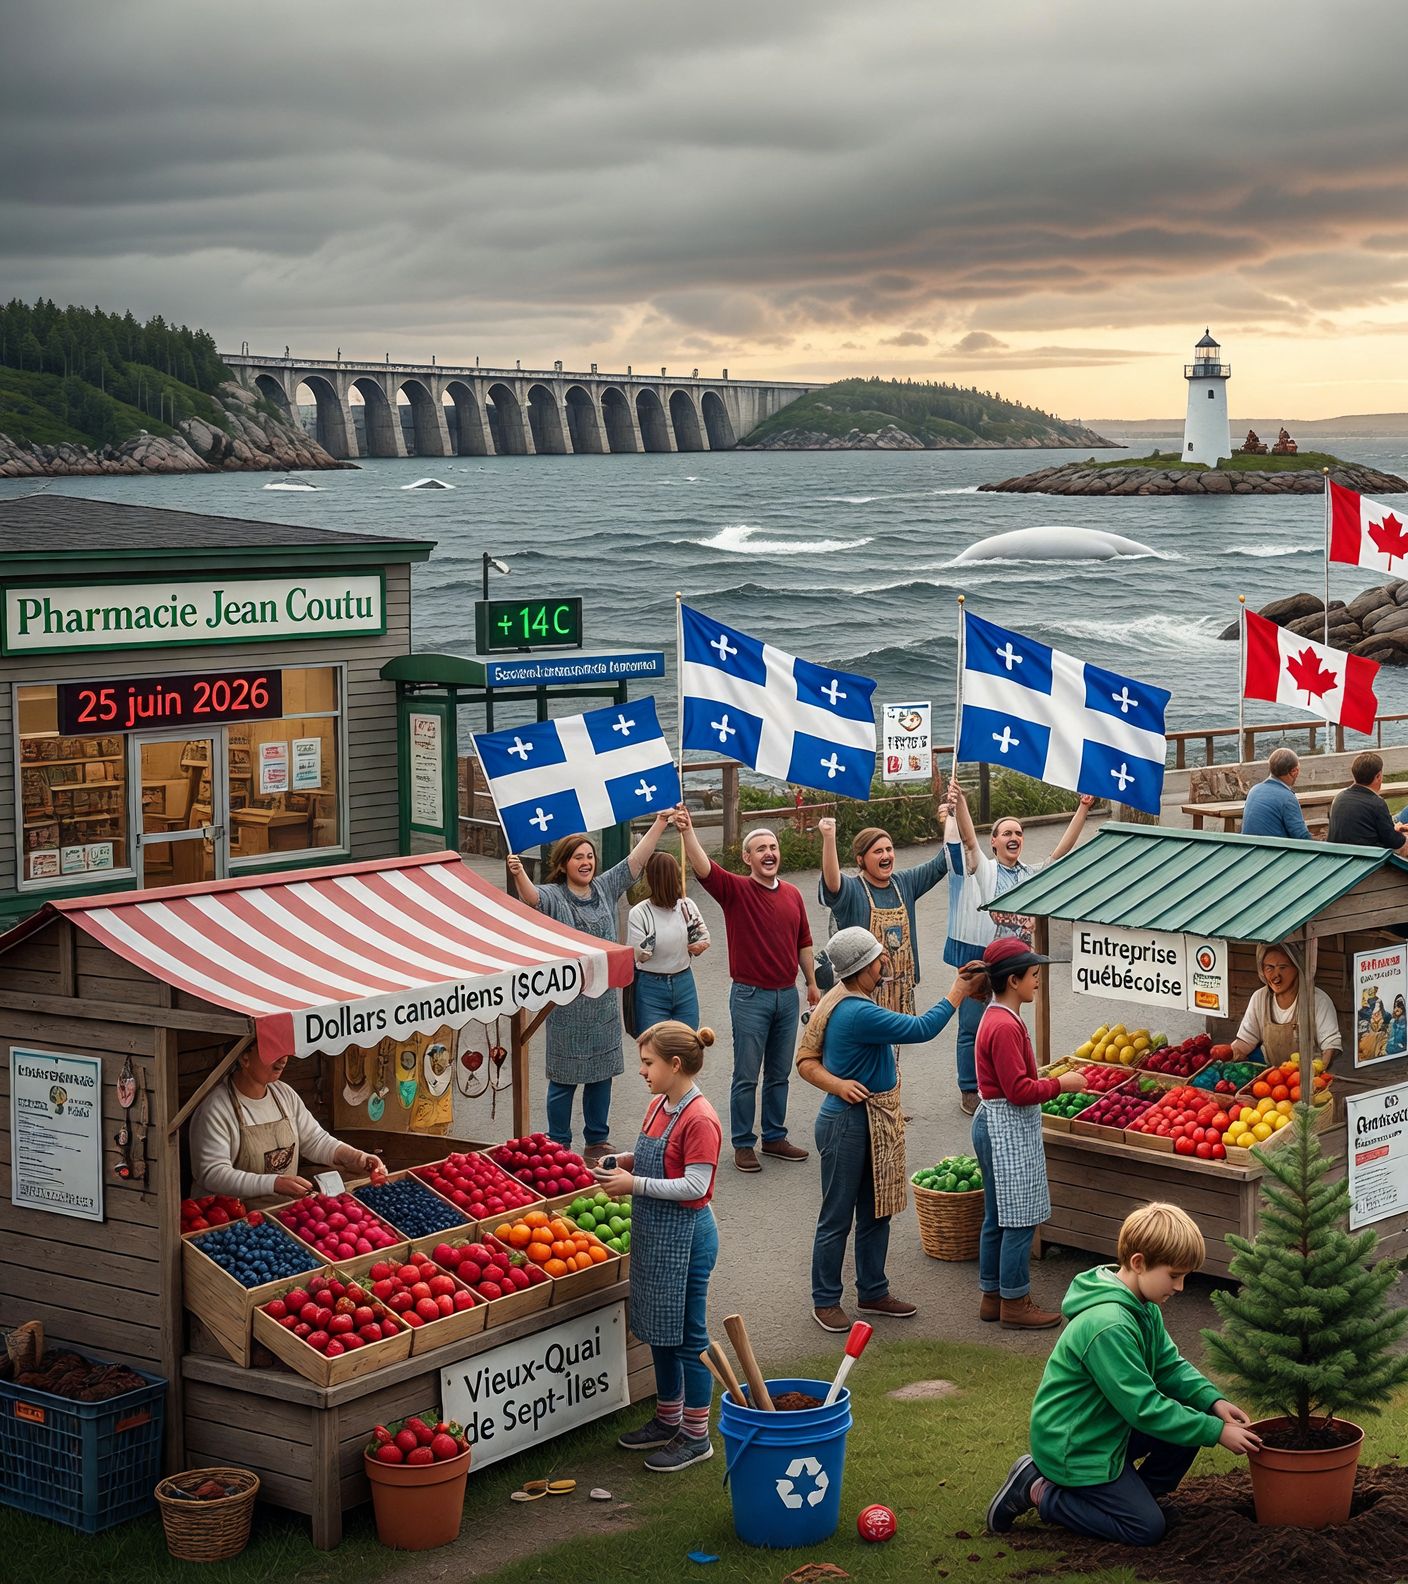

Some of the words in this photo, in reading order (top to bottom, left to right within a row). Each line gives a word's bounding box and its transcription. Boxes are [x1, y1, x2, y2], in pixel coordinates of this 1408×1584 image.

[17, 594, 198, 635] Pharmacie
[206, 590, 279, 628] Jean
[286, 587, 374, 621] Coutu
[77, 688, 118, 723] 25
[125, 685, 182, 727] juin
[193, 677, 269, 713] 2026
[1080, 932, 1177, 965] Entreprise
[1077, 964, 1182, 996] québécoise
[305, 1004, 387, 1043] Dollars
[394, 984, 503, 1026] canadiens
[463, 1325, 601, 1403] Vieux-Quai
[464, 1411, 495, 1446] de
